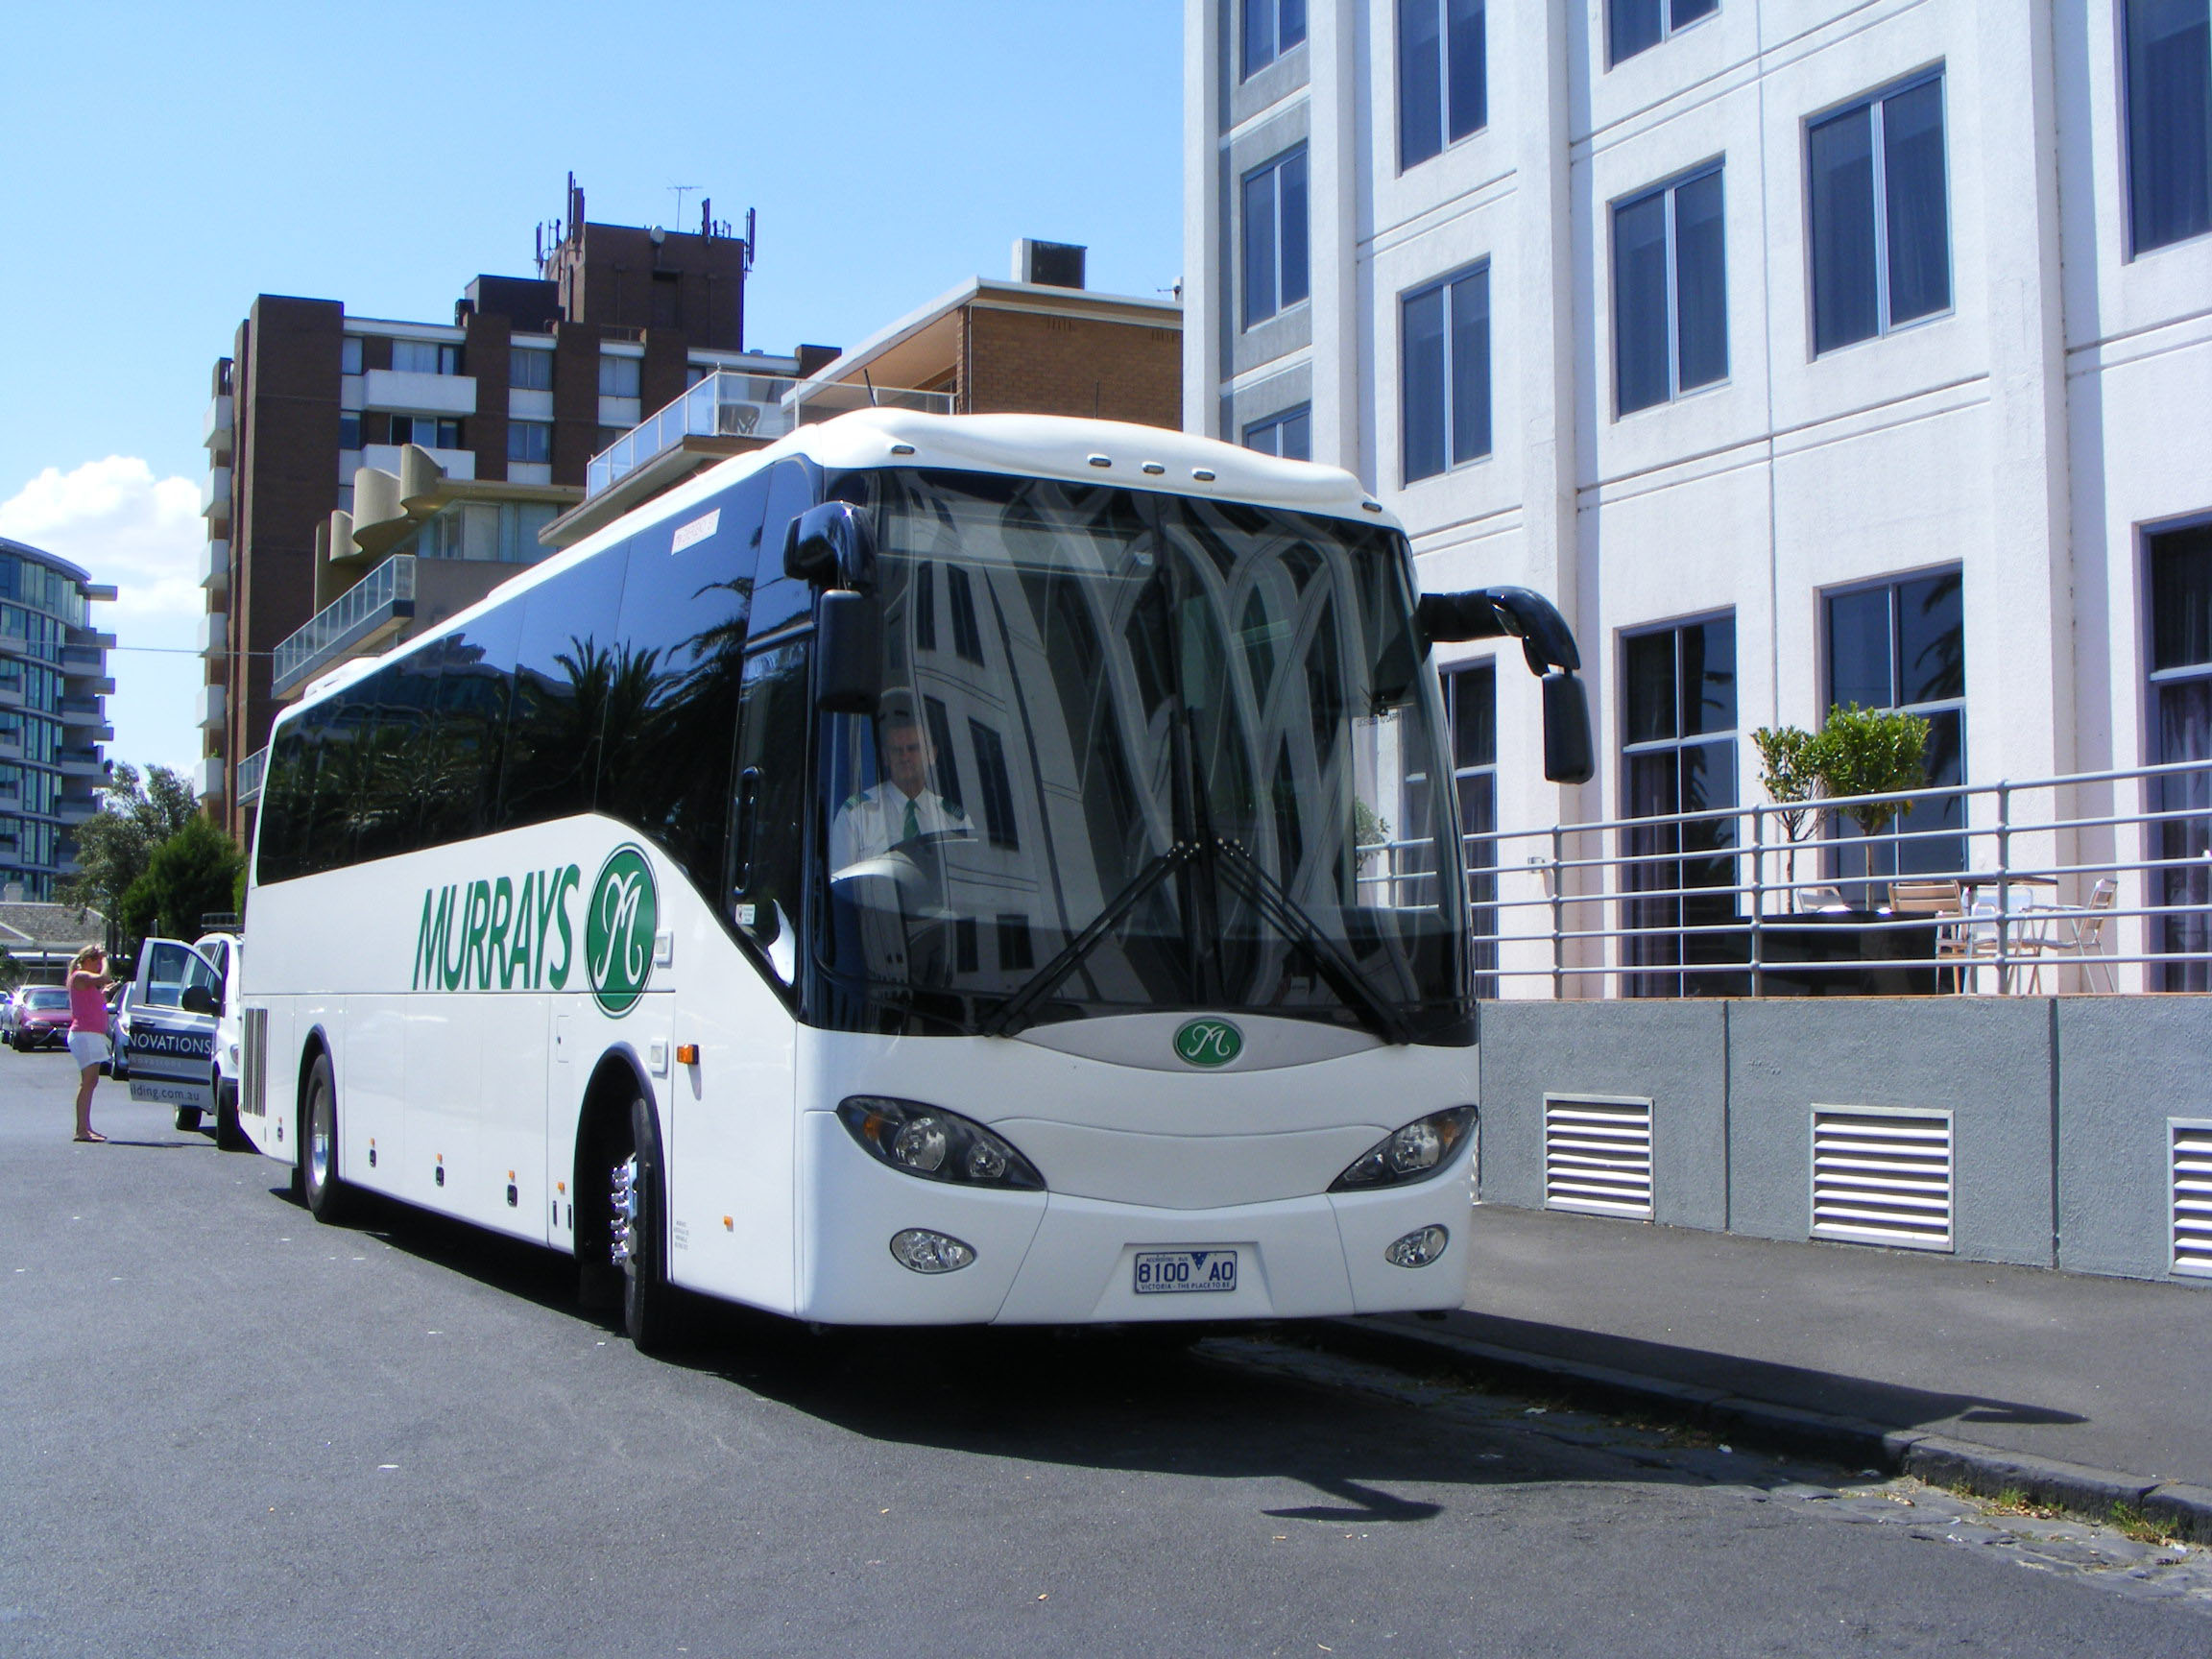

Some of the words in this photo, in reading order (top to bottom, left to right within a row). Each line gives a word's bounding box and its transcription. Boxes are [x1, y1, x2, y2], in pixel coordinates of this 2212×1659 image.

[413, 864, 581, 991] MURRAYS
[129, 1033, 211, 1054] NOVATIONS
[1139, 1262, 1189, 1283] 8100
